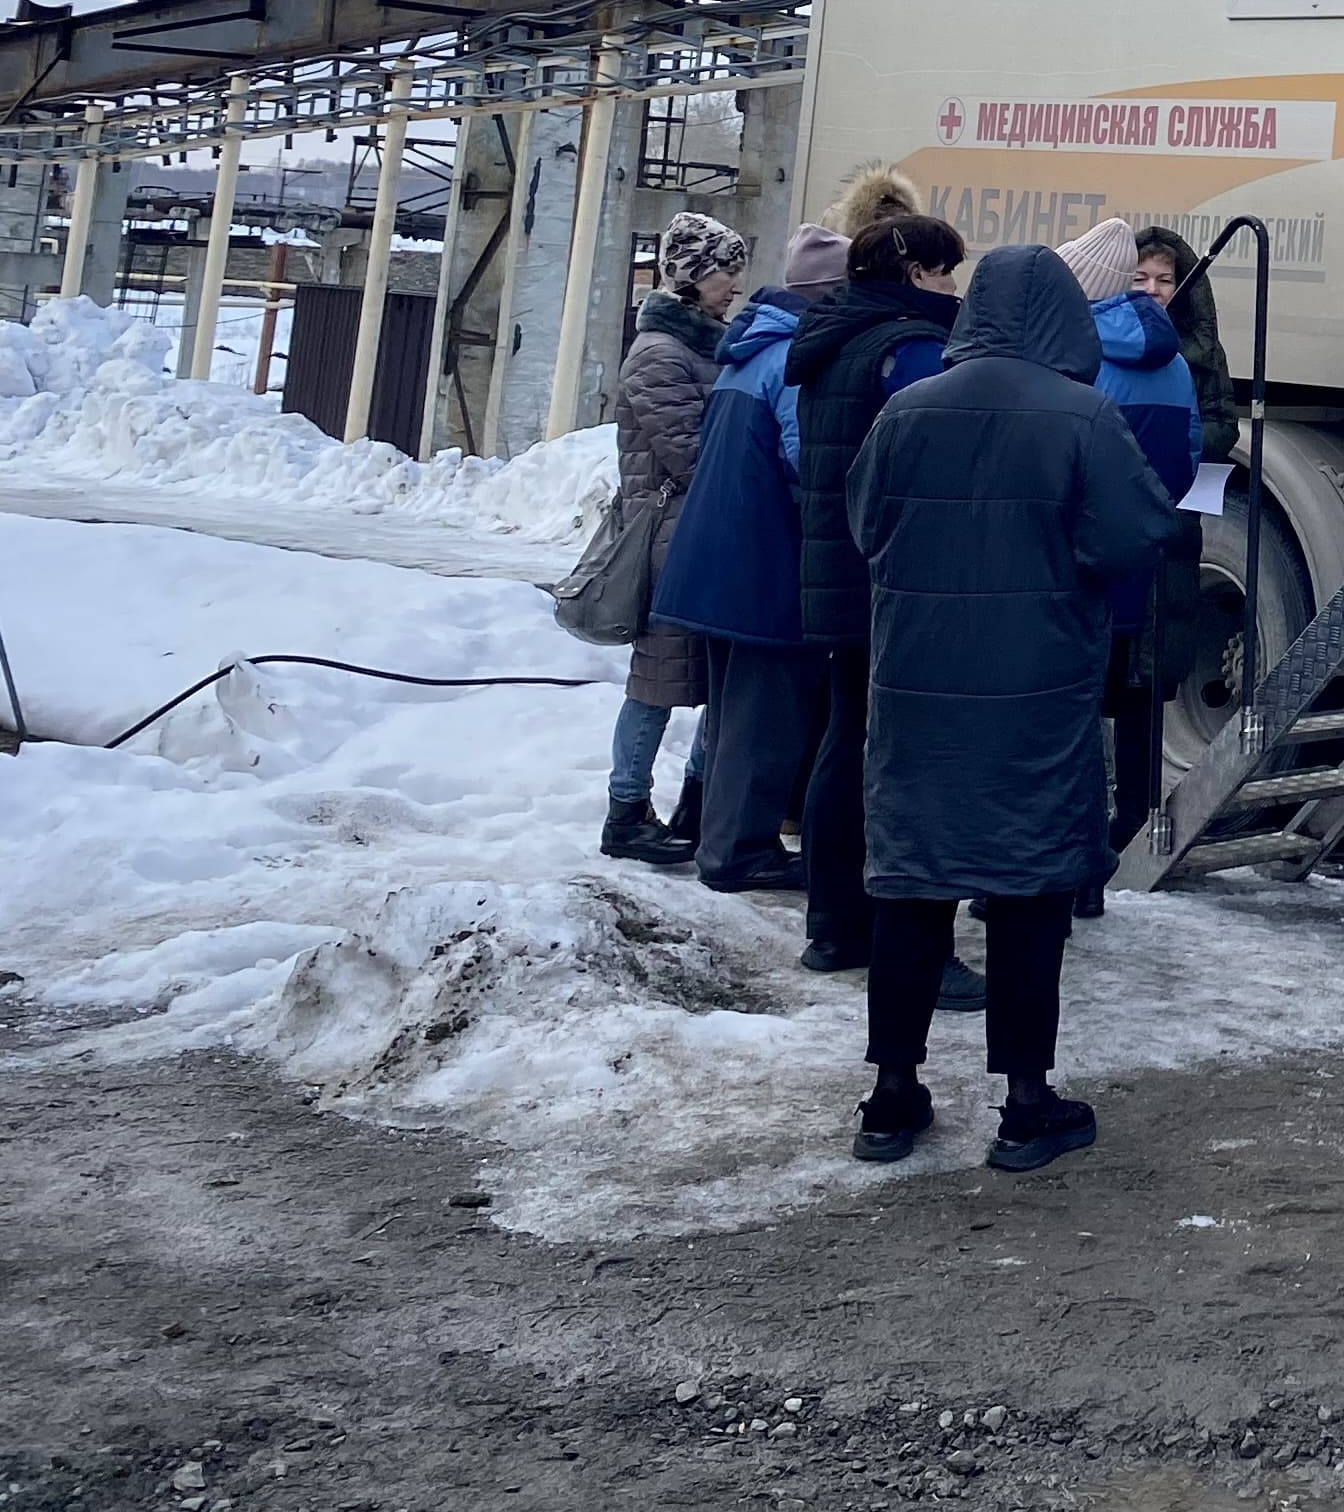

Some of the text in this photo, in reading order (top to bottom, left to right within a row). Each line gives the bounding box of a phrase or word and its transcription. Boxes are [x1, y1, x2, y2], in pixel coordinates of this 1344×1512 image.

[976, 102, 1277, 149] МЕДИЦИНСКАЯ СЛУЖБА
[929, 185, 1107, 250] КАБИНЕТ
